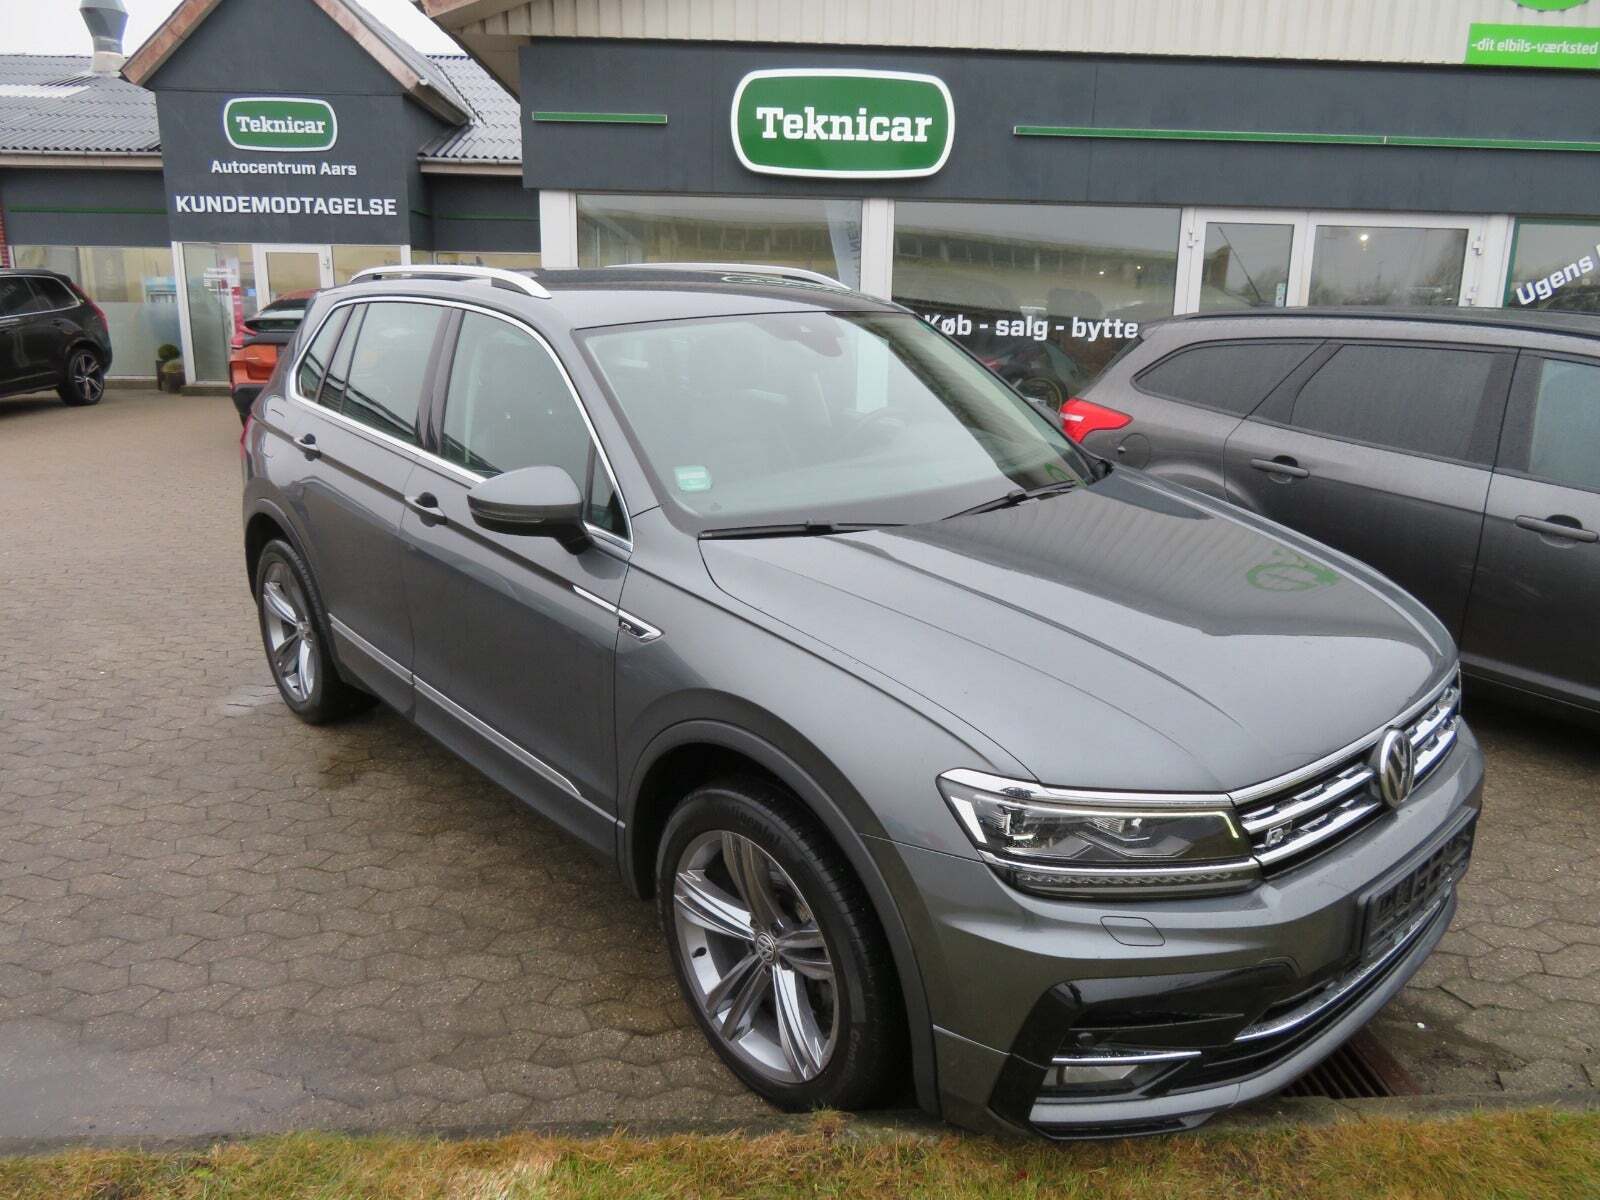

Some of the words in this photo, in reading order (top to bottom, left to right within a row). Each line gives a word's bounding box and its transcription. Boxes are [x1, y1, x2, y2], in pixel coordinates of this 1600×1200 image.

[1471, 38, 1494, 51] -dit
[1497, 39, 1598, 55] elbils-værksted
[235, 116, 325, 134] Teknicar
[756, 106, 932, 142] Teknicar
[211, 160, 316, 175] Autocentrum
[320, 162, 357, 176] Aars
[175, 195, 397, 216] KUNDEMODTAGELSE
[1516, 255, 1594, 305] Ugens
[995, 316, 1048, 341] salg
[1071, 317, 1139, 342] bytte
